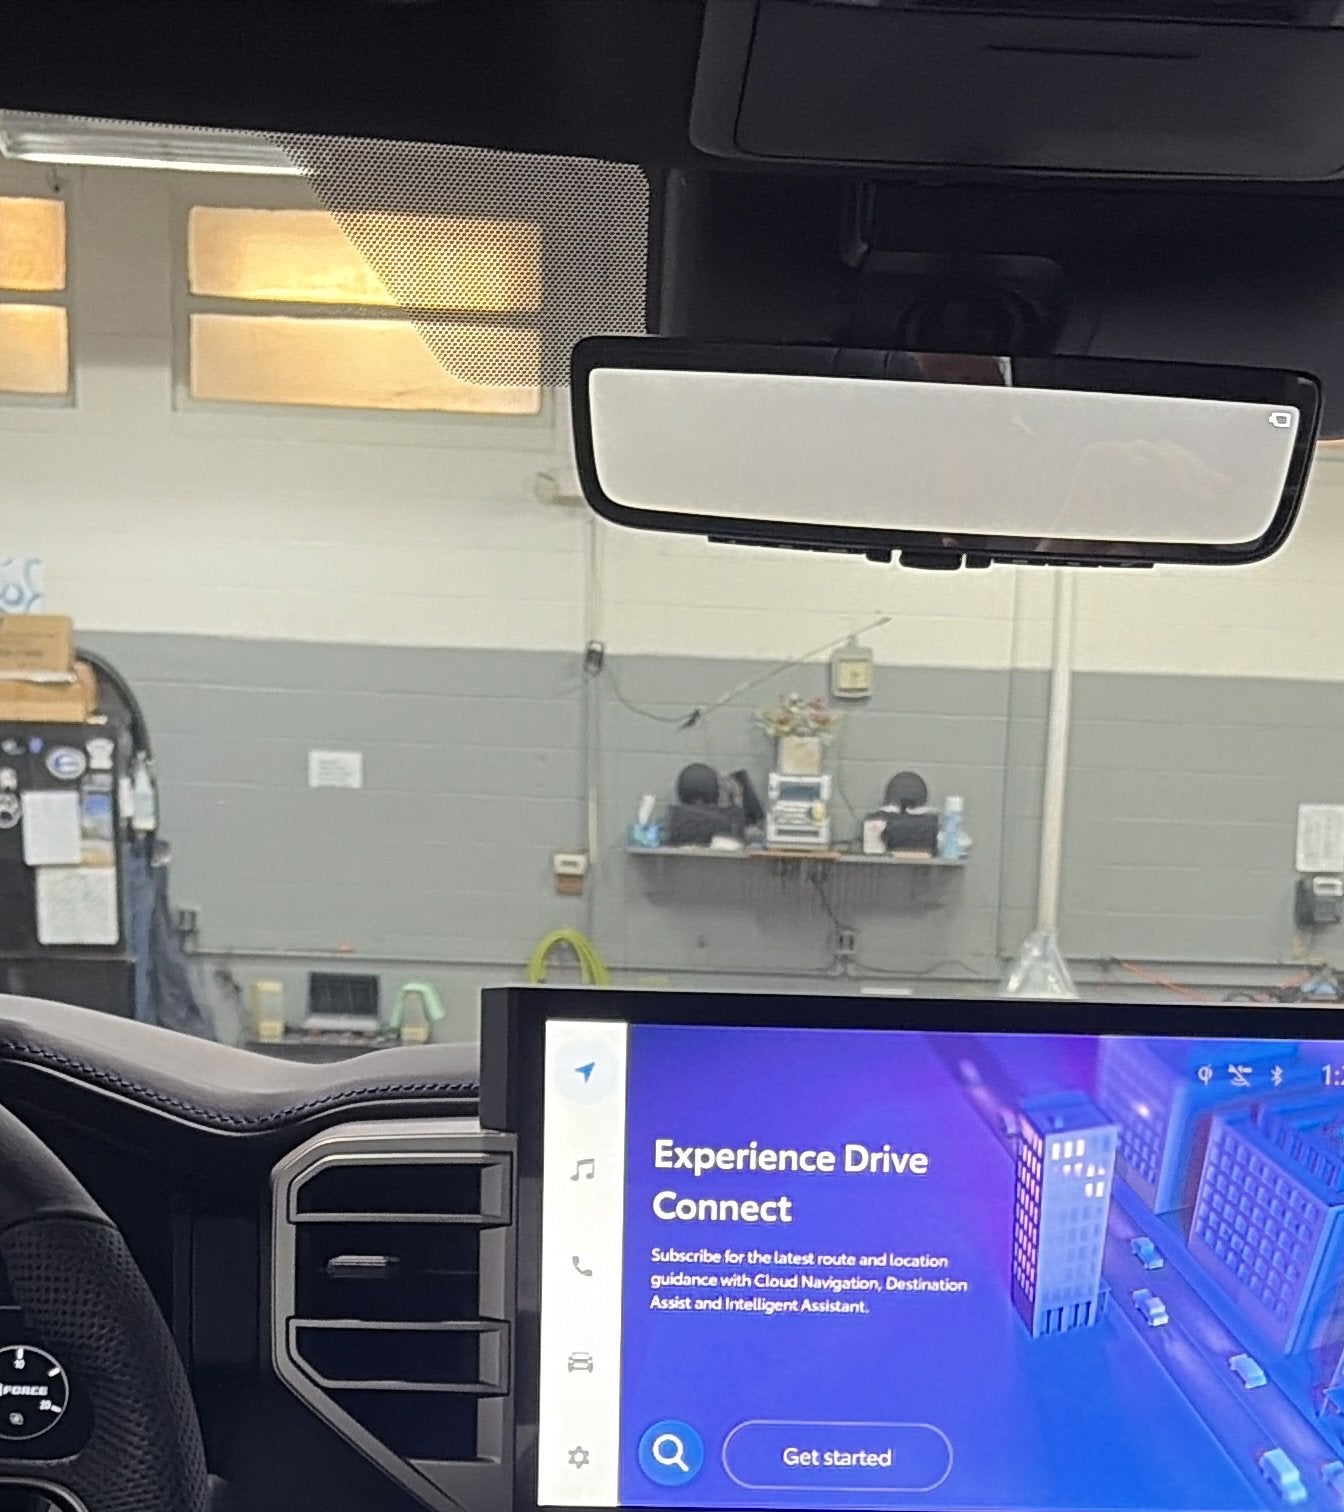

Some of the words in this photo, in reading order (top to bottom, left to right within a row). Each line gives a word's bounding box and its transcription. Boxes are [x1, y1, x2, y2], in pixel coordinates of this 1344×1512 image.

[654, 1139, 836, 1176] Experience
[844, 1143, 929, 1174] Drive
[653, 1190, 793, 1223] Connect
[651, 1248, 722, 1264] Subscribe
[724, 1249, 746, 1264] for
[747, 1250, 772, 1265] the
[774, 1251, 816, 1266] latest
[817, 1253, 857, 1267] route
[859, 1253, 887, 1267] and
[889, 1253, 949, 1268] location
[651, 1272, 718, 1289] guidance
[720, 1273, 752, 1287] with
[754, 1273, 798, 1289] Cloud
[801, 1275, 883, 1293] Navigation,
[886, 1276, 968, 1292] Destination
[650, 1295, 692, 1310] Assist
[694, 1296, 722, 1311] and
[725, 1296, 799, 1315] Intelligent
[801, 1299, 871, 1314] Assistant.
[782, 1447, 819, 1466] Get
[823, 1448, 893, 1467] started
